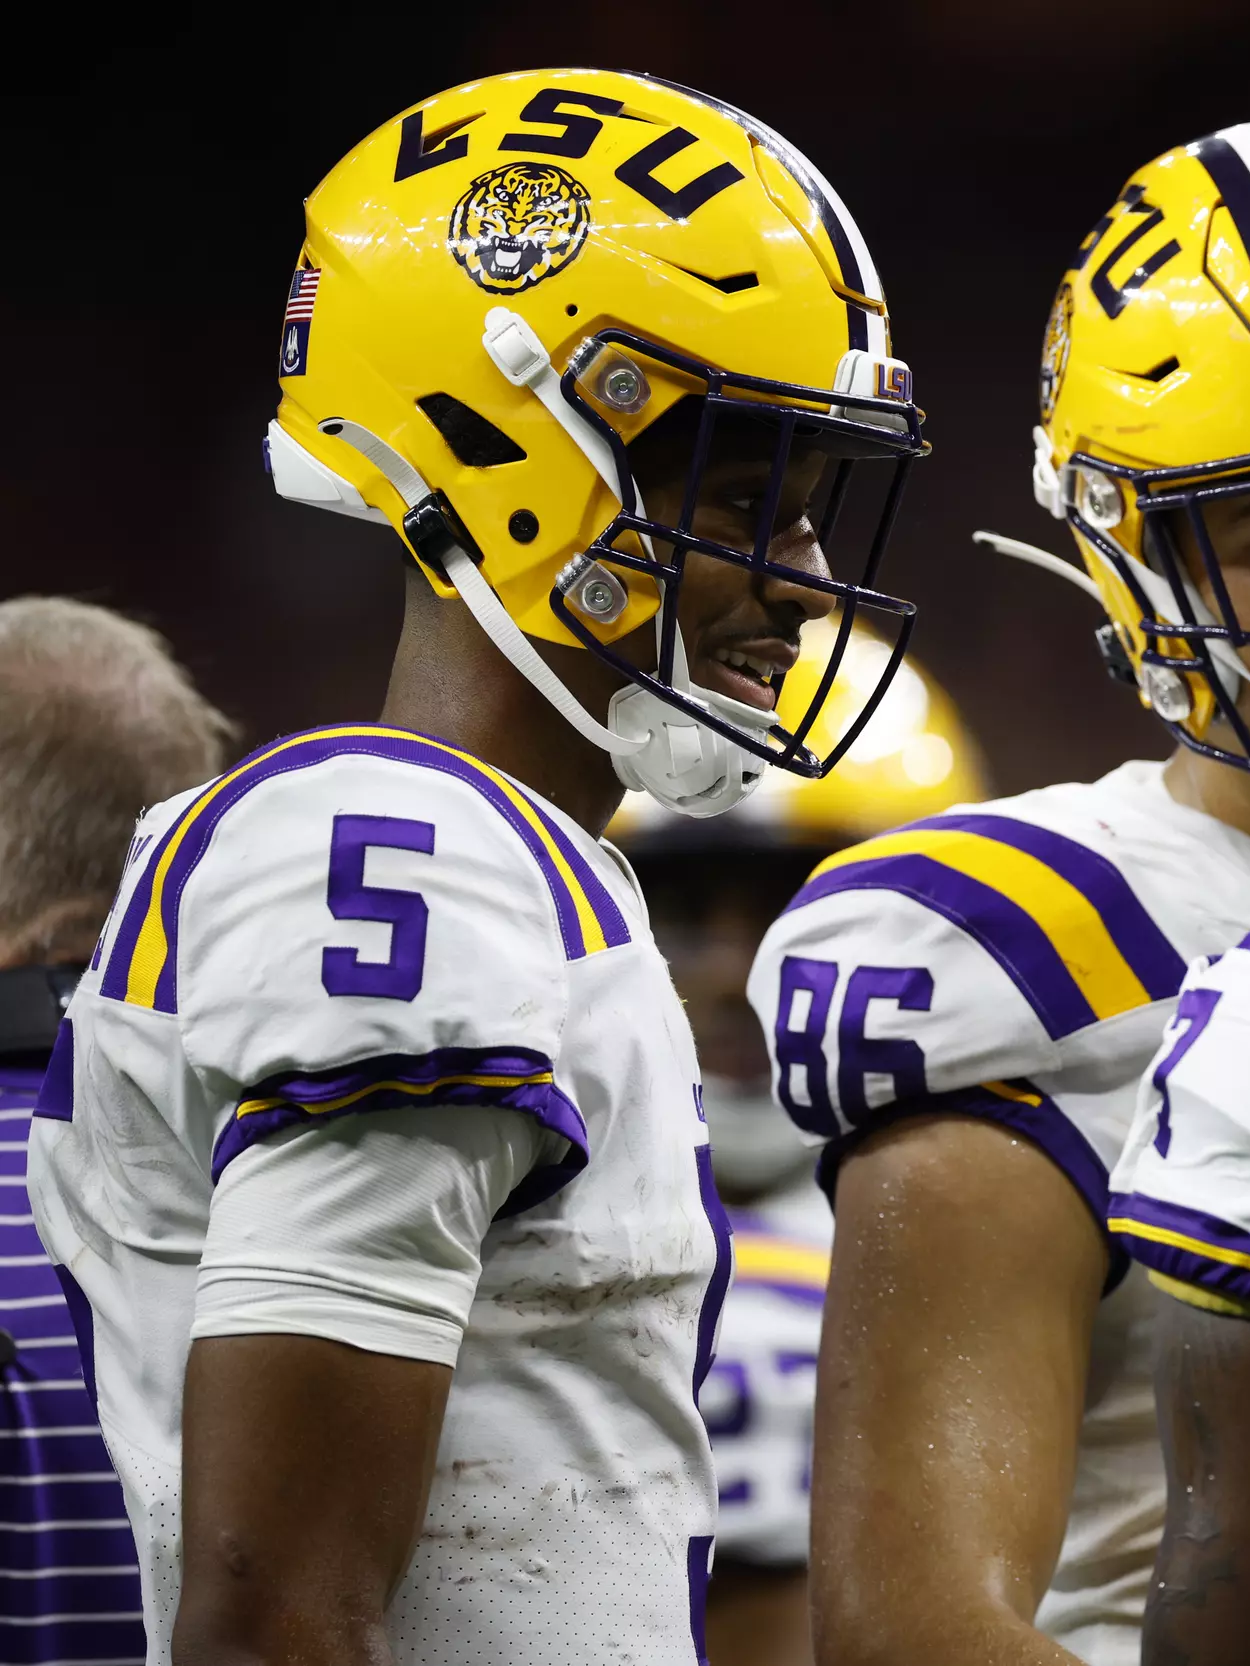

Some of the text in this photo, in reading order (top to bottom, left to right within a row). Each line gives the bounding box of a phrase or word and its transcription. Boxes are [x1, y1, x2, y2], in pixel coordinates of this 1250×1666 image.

[394, 88, 746, 221] LSU
[873, 362, 913, 402] LSU
[322, 814, 435, 1001] 5
[775, 956, 934, 1138] 86
